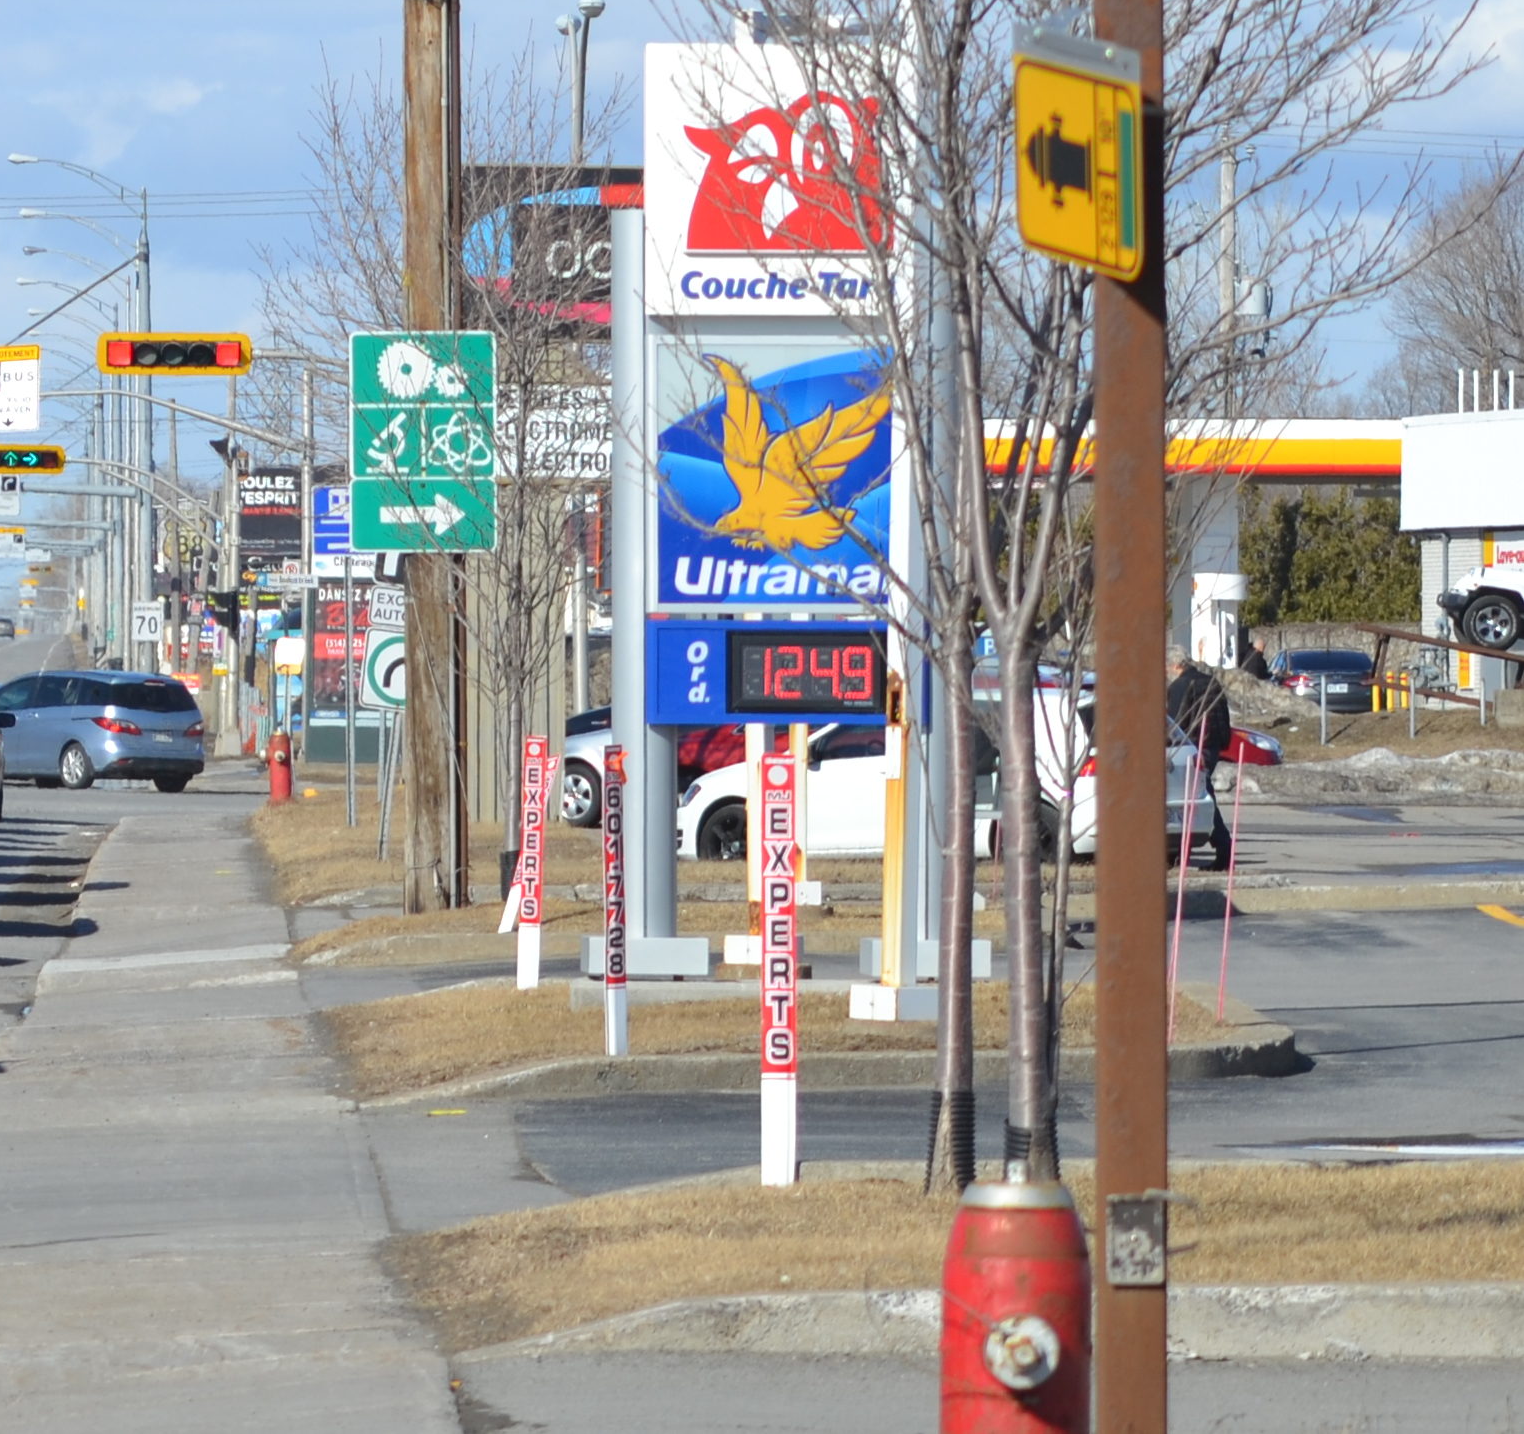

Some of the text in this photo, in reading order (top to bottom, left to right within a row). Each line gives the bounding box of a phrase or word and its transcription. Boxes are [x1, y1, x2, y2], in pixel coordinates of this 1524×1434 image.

[3, 371, 34, 382] BUS
[135, 615, 158, 635] 70
[521, 766, 541, 917] EXPERTS
[768, 806, 792, 1062] EXPERTS
